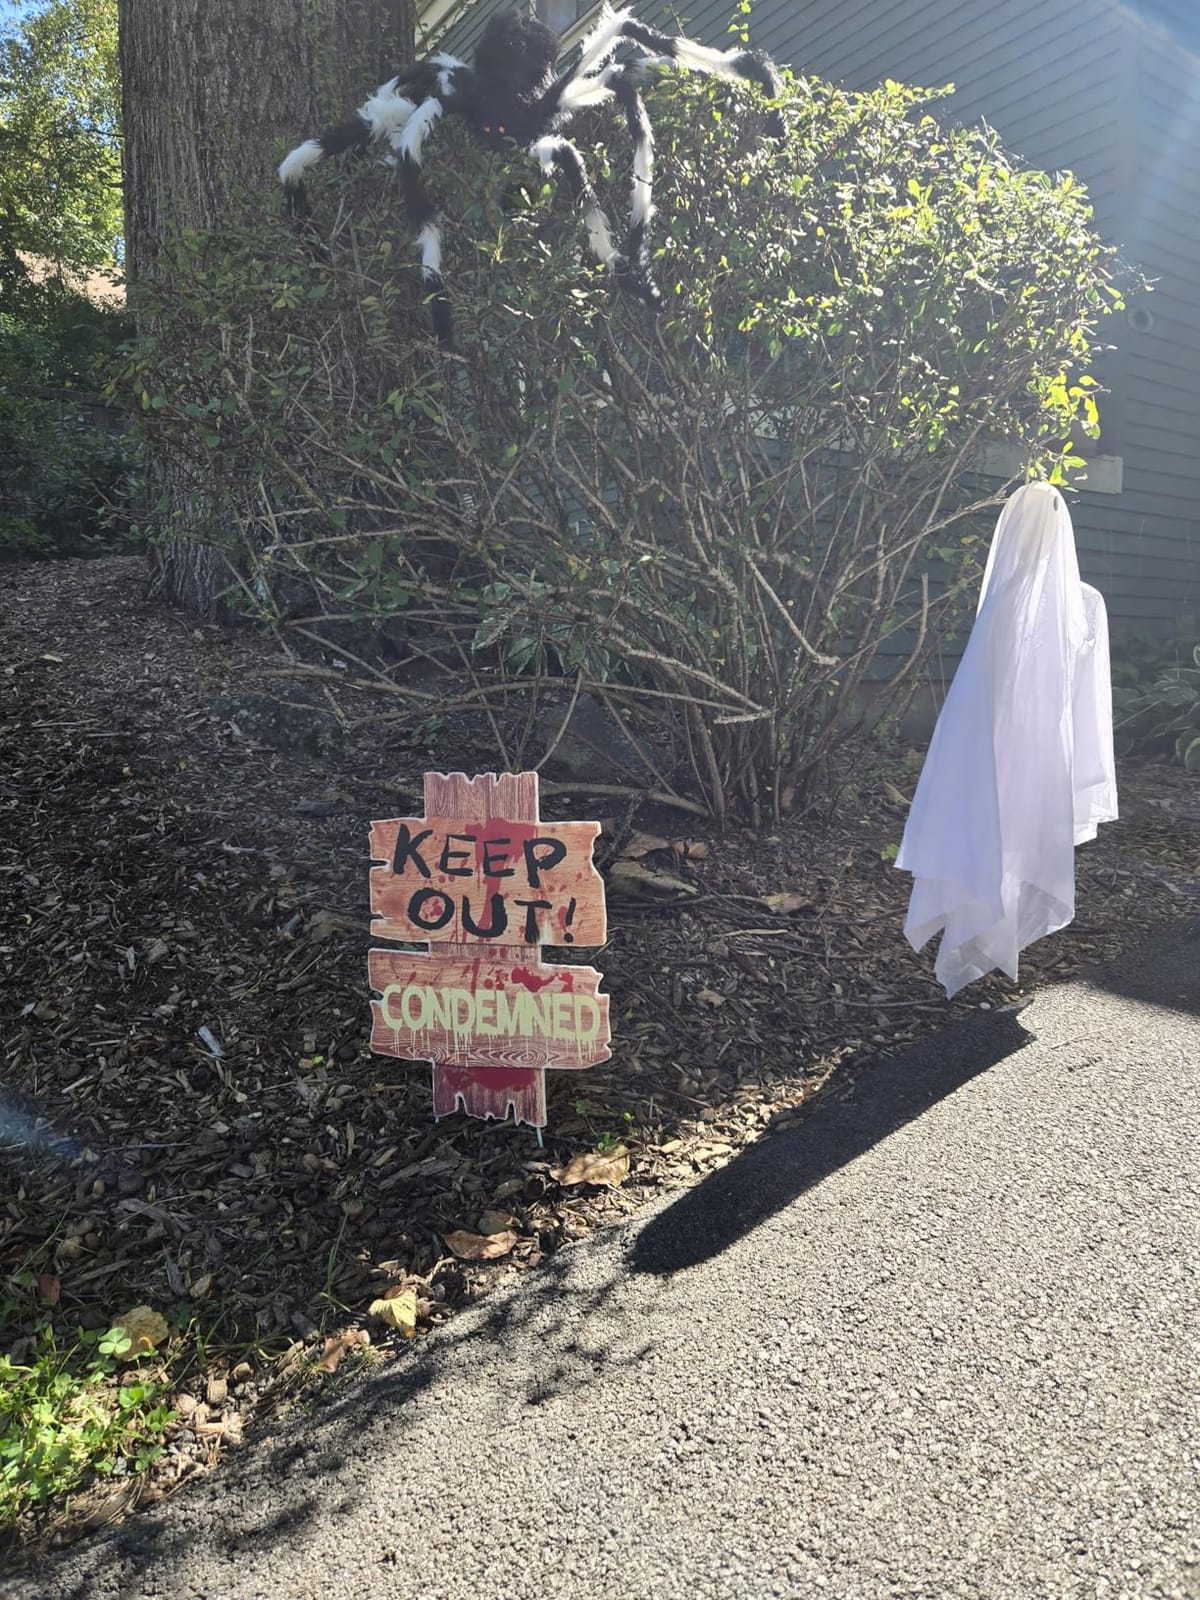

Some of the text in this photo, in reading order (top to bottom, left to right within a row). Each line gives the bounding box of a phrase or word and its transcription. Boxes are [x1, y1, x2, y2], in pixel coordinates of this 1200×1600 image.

[393, 824, 567, 888] KEEP
[407, 887, 577, 944] OUT!
[381, 984, 601, 1044] CONDEMNED
